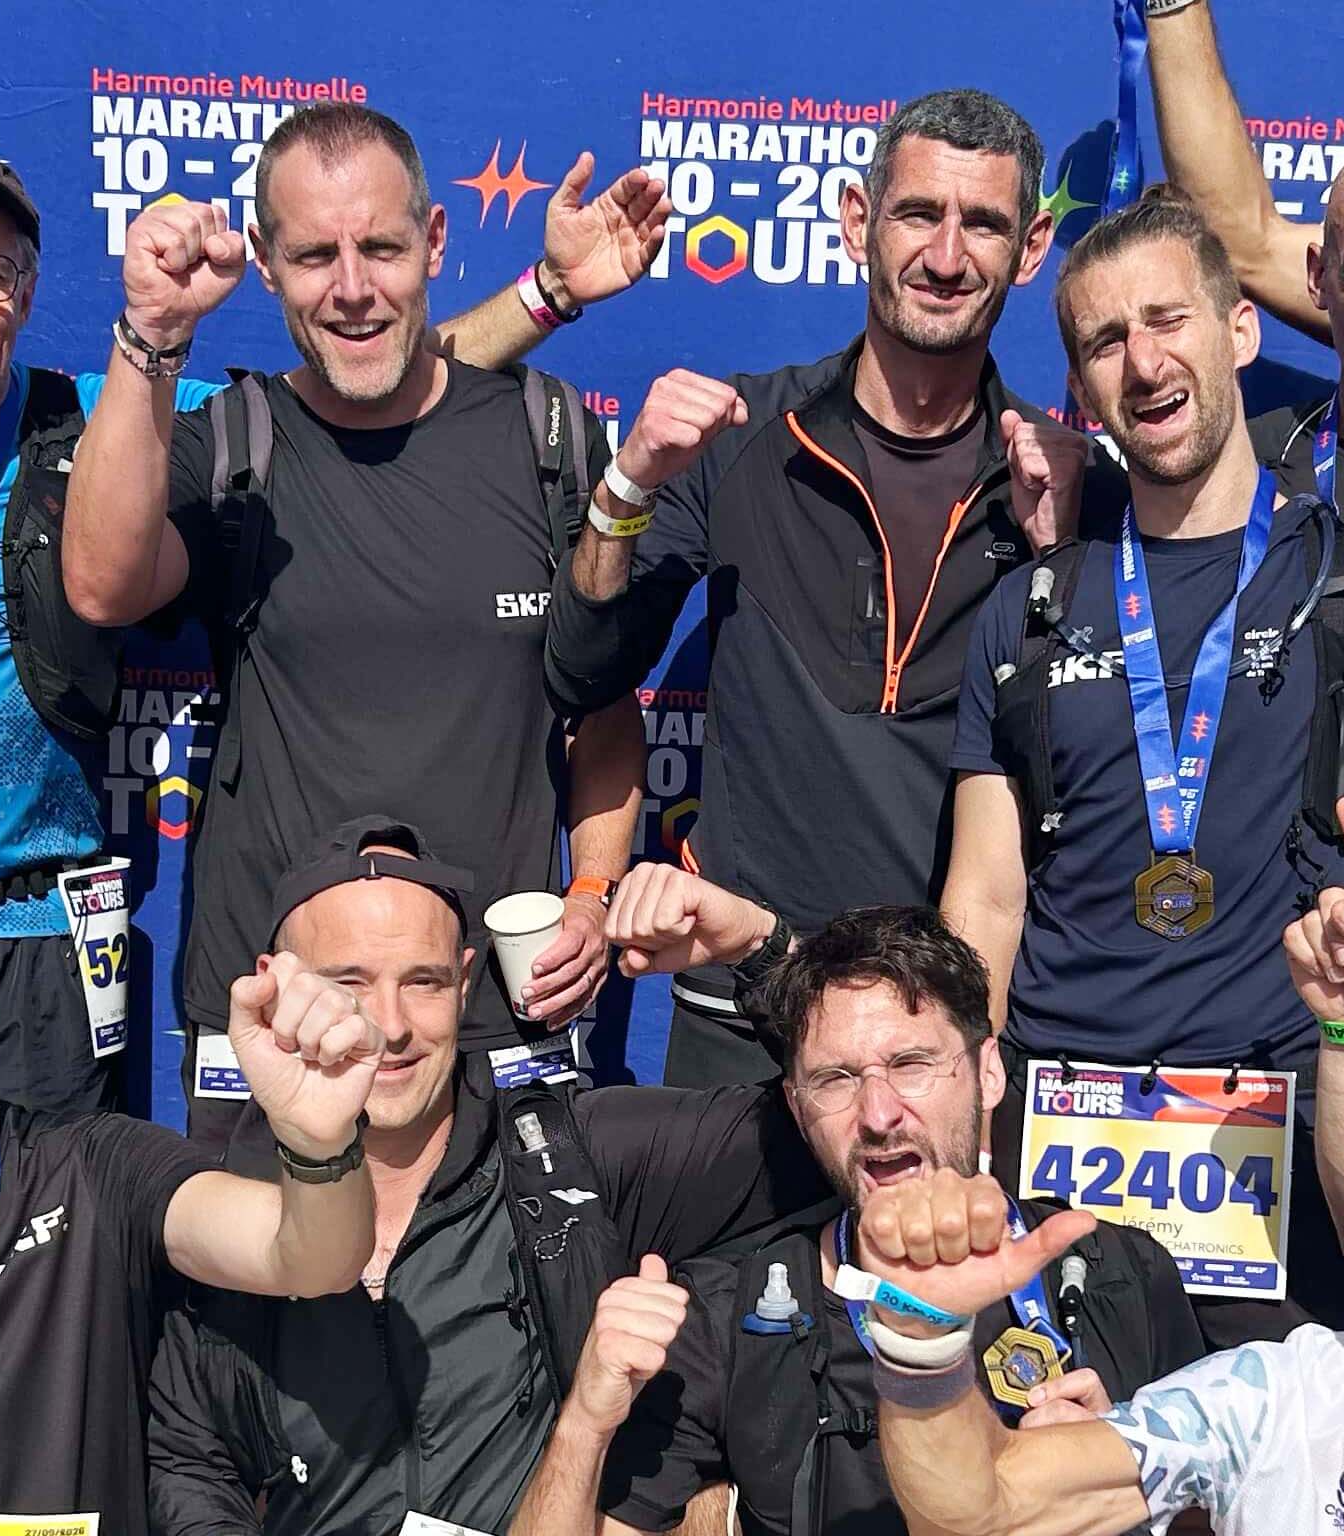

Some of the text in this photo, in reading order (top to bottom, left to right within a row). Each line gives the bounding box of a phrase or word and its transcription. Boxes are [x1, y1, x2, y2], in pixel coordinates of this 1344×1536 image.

[92, 68, 367, 103] Harmonie Mutuelle
[92, 96, 296, 140] MARATH
[642, 90, 897, 123] Harmonie Mutuell
[640, 120, 878, 165] MARATHO
[1244, 116, 1328, 140] monie
[92, 136, 169, 193] 10
[649, 215, 870, 285] TOUR
[548, 396, 561, 447] Quechua
[495, 592, 553, 619] SKF
[1178, 767, 1196, 778] 09
[1180, 757, 1197, 768] 27
[1038, 1093, 1124, 1116] TOURS
[1031, 1144, 1279, 1217] 42404
[881, 1290, 899, 1307] 20
